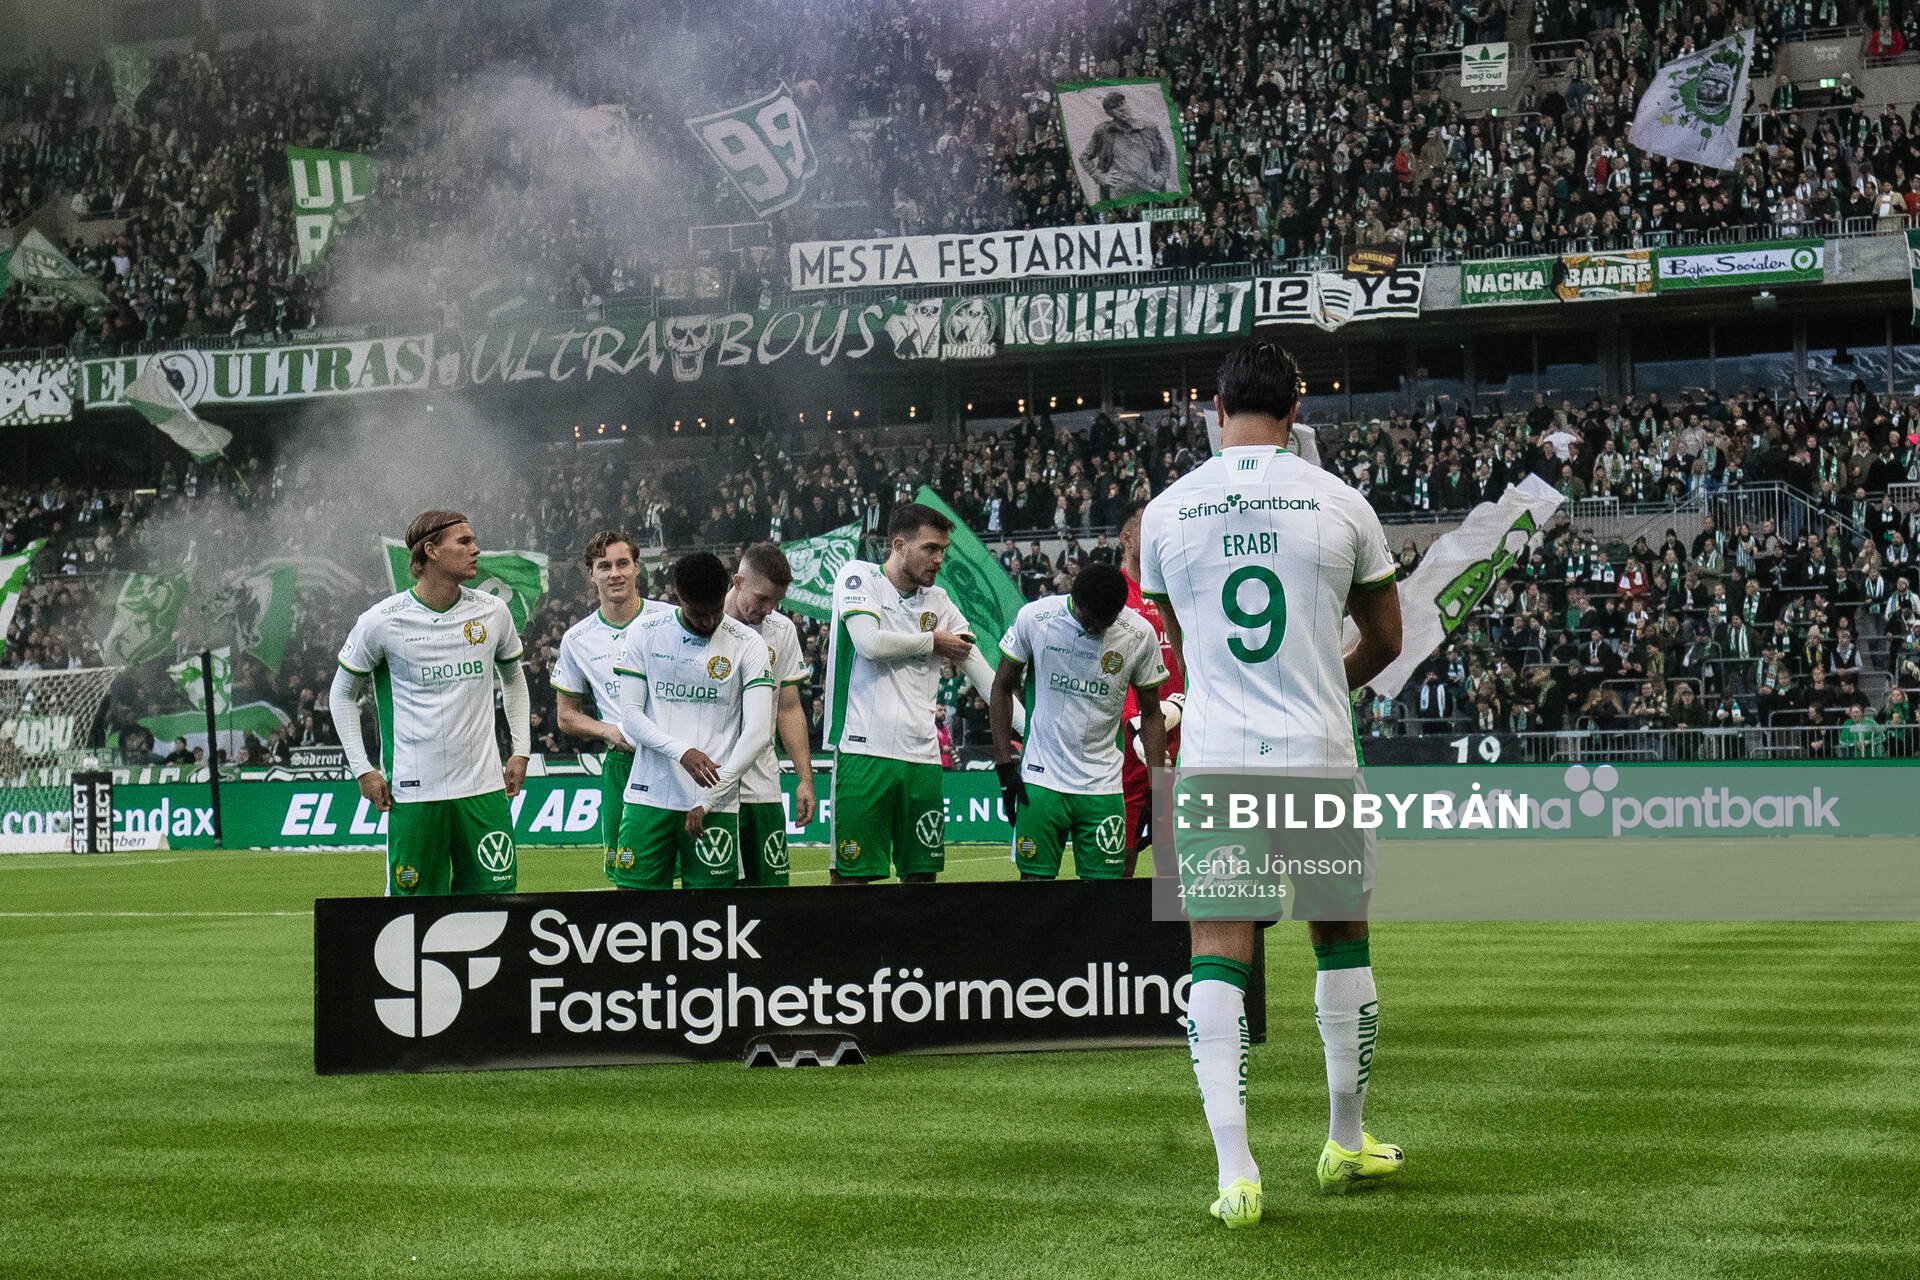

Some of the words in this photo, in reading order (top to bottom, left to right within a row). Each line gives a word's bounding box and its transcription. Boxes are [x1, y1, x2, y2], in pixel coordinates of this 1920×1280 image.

[800, 243, 918, 286] MESTA
[938, 227, 1144, 278] FESTARNA!
[1466, 270, 1545, 294] NACKA
[1565, 263, 1652, 287] BAJARE
[1004, 281, 1252, 346] KOLLEKTIVET
[1260, 280, 1308, 313] 12
[211, 337, 427, 399] ULTRAS
[470, 320, 665, 384] ULTRA
[716, 303, 884, 366] BOYS
[1178, 500, 1230, 521] Sefina
[1239, 496, 1320, 514] pantbank
[1223, 531, 1279, 558] ERABI
[1221, 565, 1287, 664] 9
[421, 660, 484, 681] PROJOB
[655, 681, 718, 699] PROJOB
[1050, 672, 1110, 696] PROJOB
[1450, 737, 1501, 764] 19
[73, 783, 88, 854] SELECT
[95, 782, 111, 853] SELECT
[281, 793, 337, 836] EL
[528, 789, 602, 832] AB
[1612, 786, 1841, 837] pantbank
[529, 905, 763, 965] Svensk
[529, 961, 1192, 1045] Fastighetsförmedling
